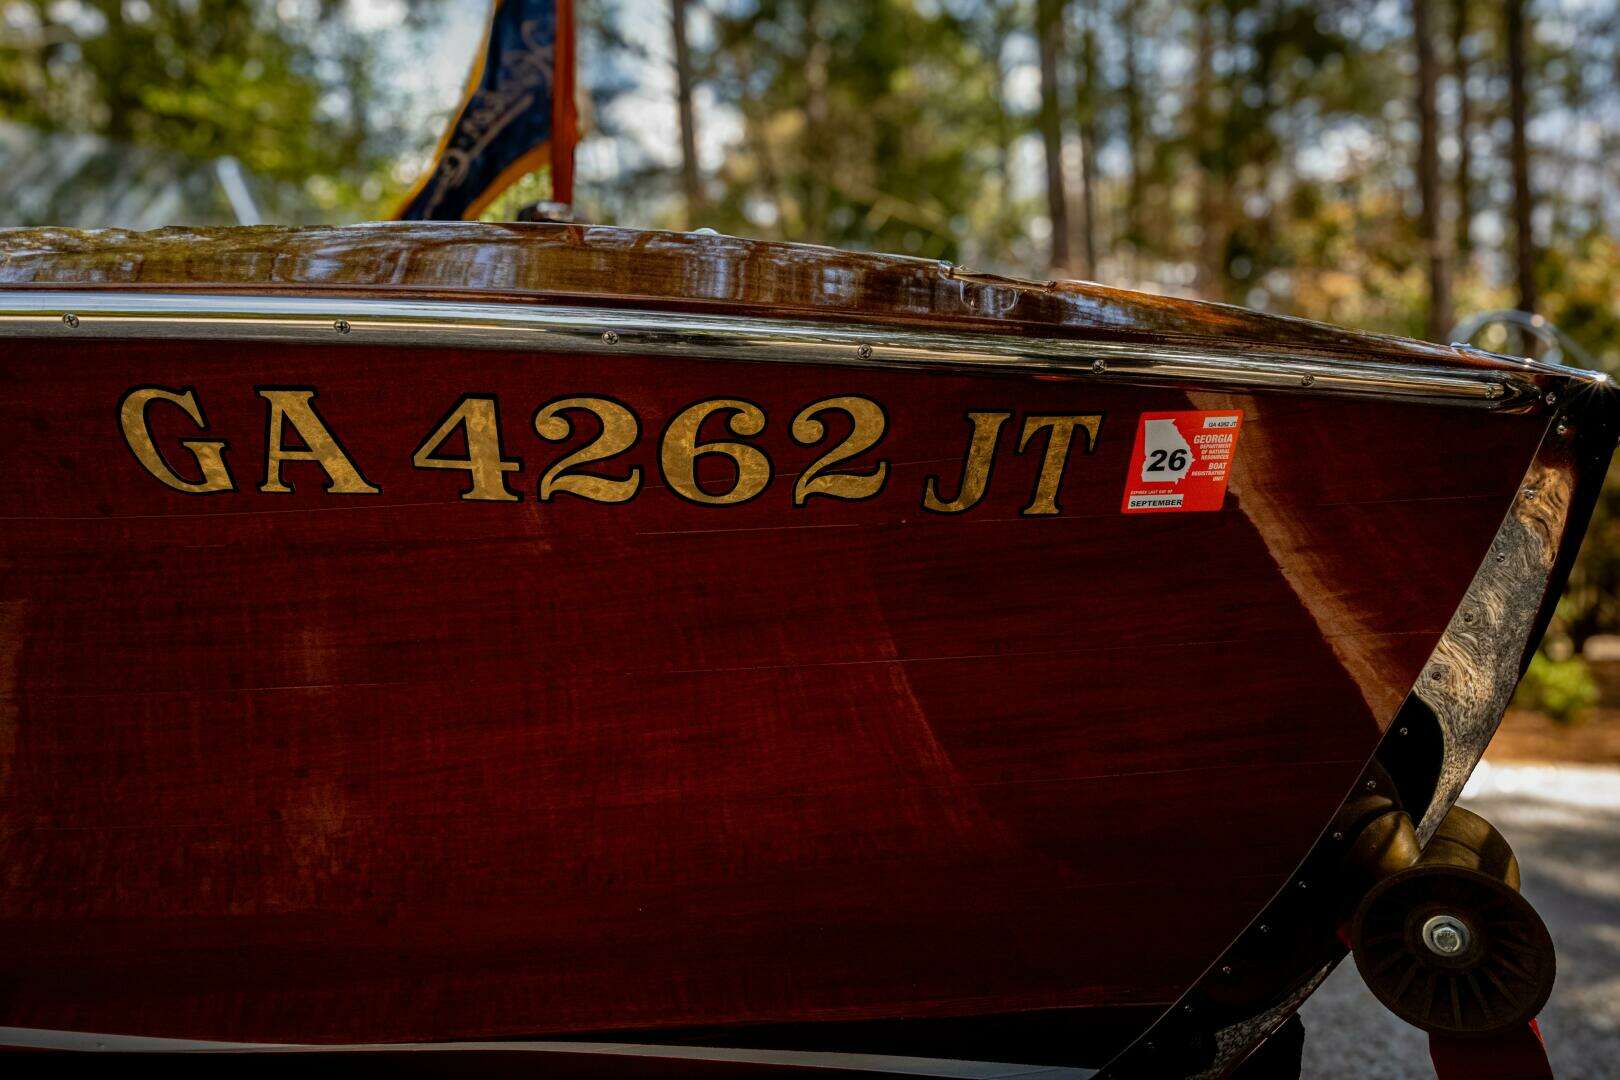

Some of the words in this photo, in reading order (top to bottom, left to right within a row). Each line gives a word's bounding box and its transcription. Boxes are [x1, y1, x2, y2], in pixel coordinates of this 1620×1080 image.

[1194, 433, 1233, 444] GEORGIA
[118, 384, 383, 497] GA
[411, 394, 891, 508] 4262
[922, 410, 1103, 517] JT
[1146, 448, 1188, 472] 26
[1208, 462, 1227, 470] BOAT
[1130, 499, 1182, 508] SEPTEMBER
